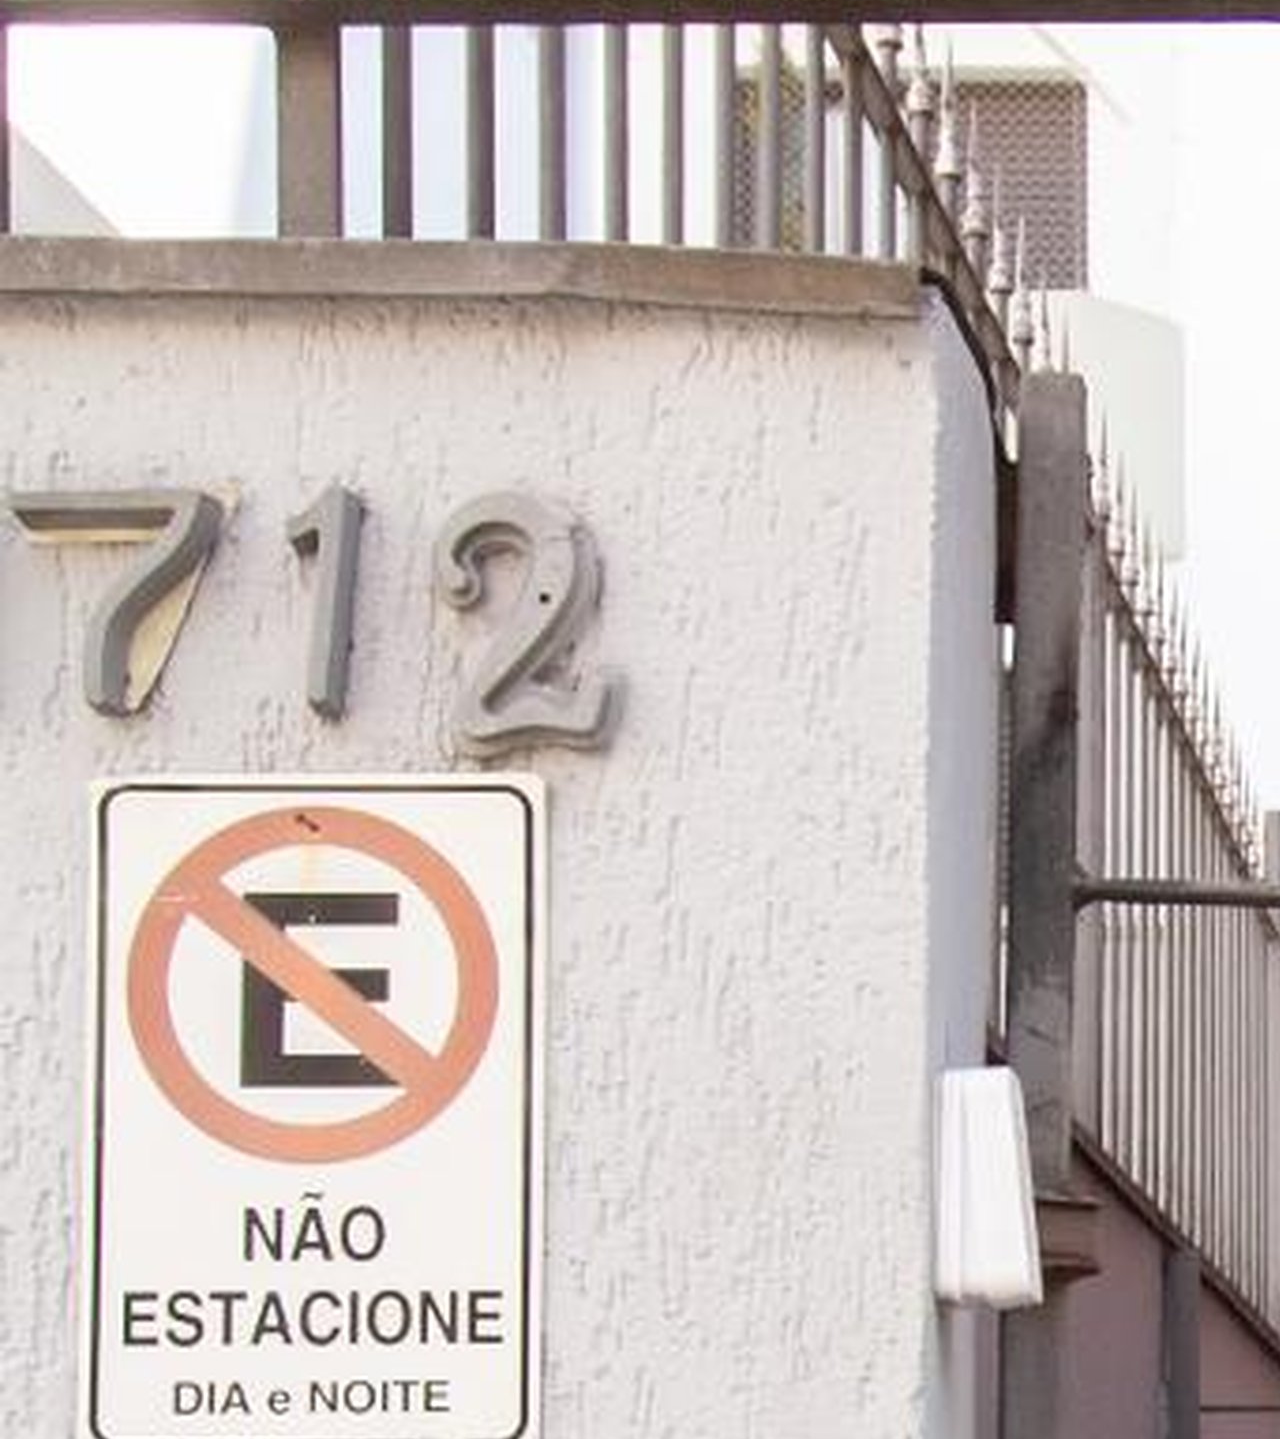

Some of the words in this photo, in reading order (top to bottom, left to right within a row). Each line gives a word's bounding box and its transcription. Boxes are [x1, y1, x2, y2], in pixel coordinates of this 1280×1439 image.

[8, 483, 632, 759] 712
[243, 1191, 388, 1263] NÃO
[121, 1289, 505, 1346] ESTACIONE
[173, 1381, 250, 1415] DIA
[268, 1391, 292, 1415] e
[308, 1379, 451, 1414] NOITE
